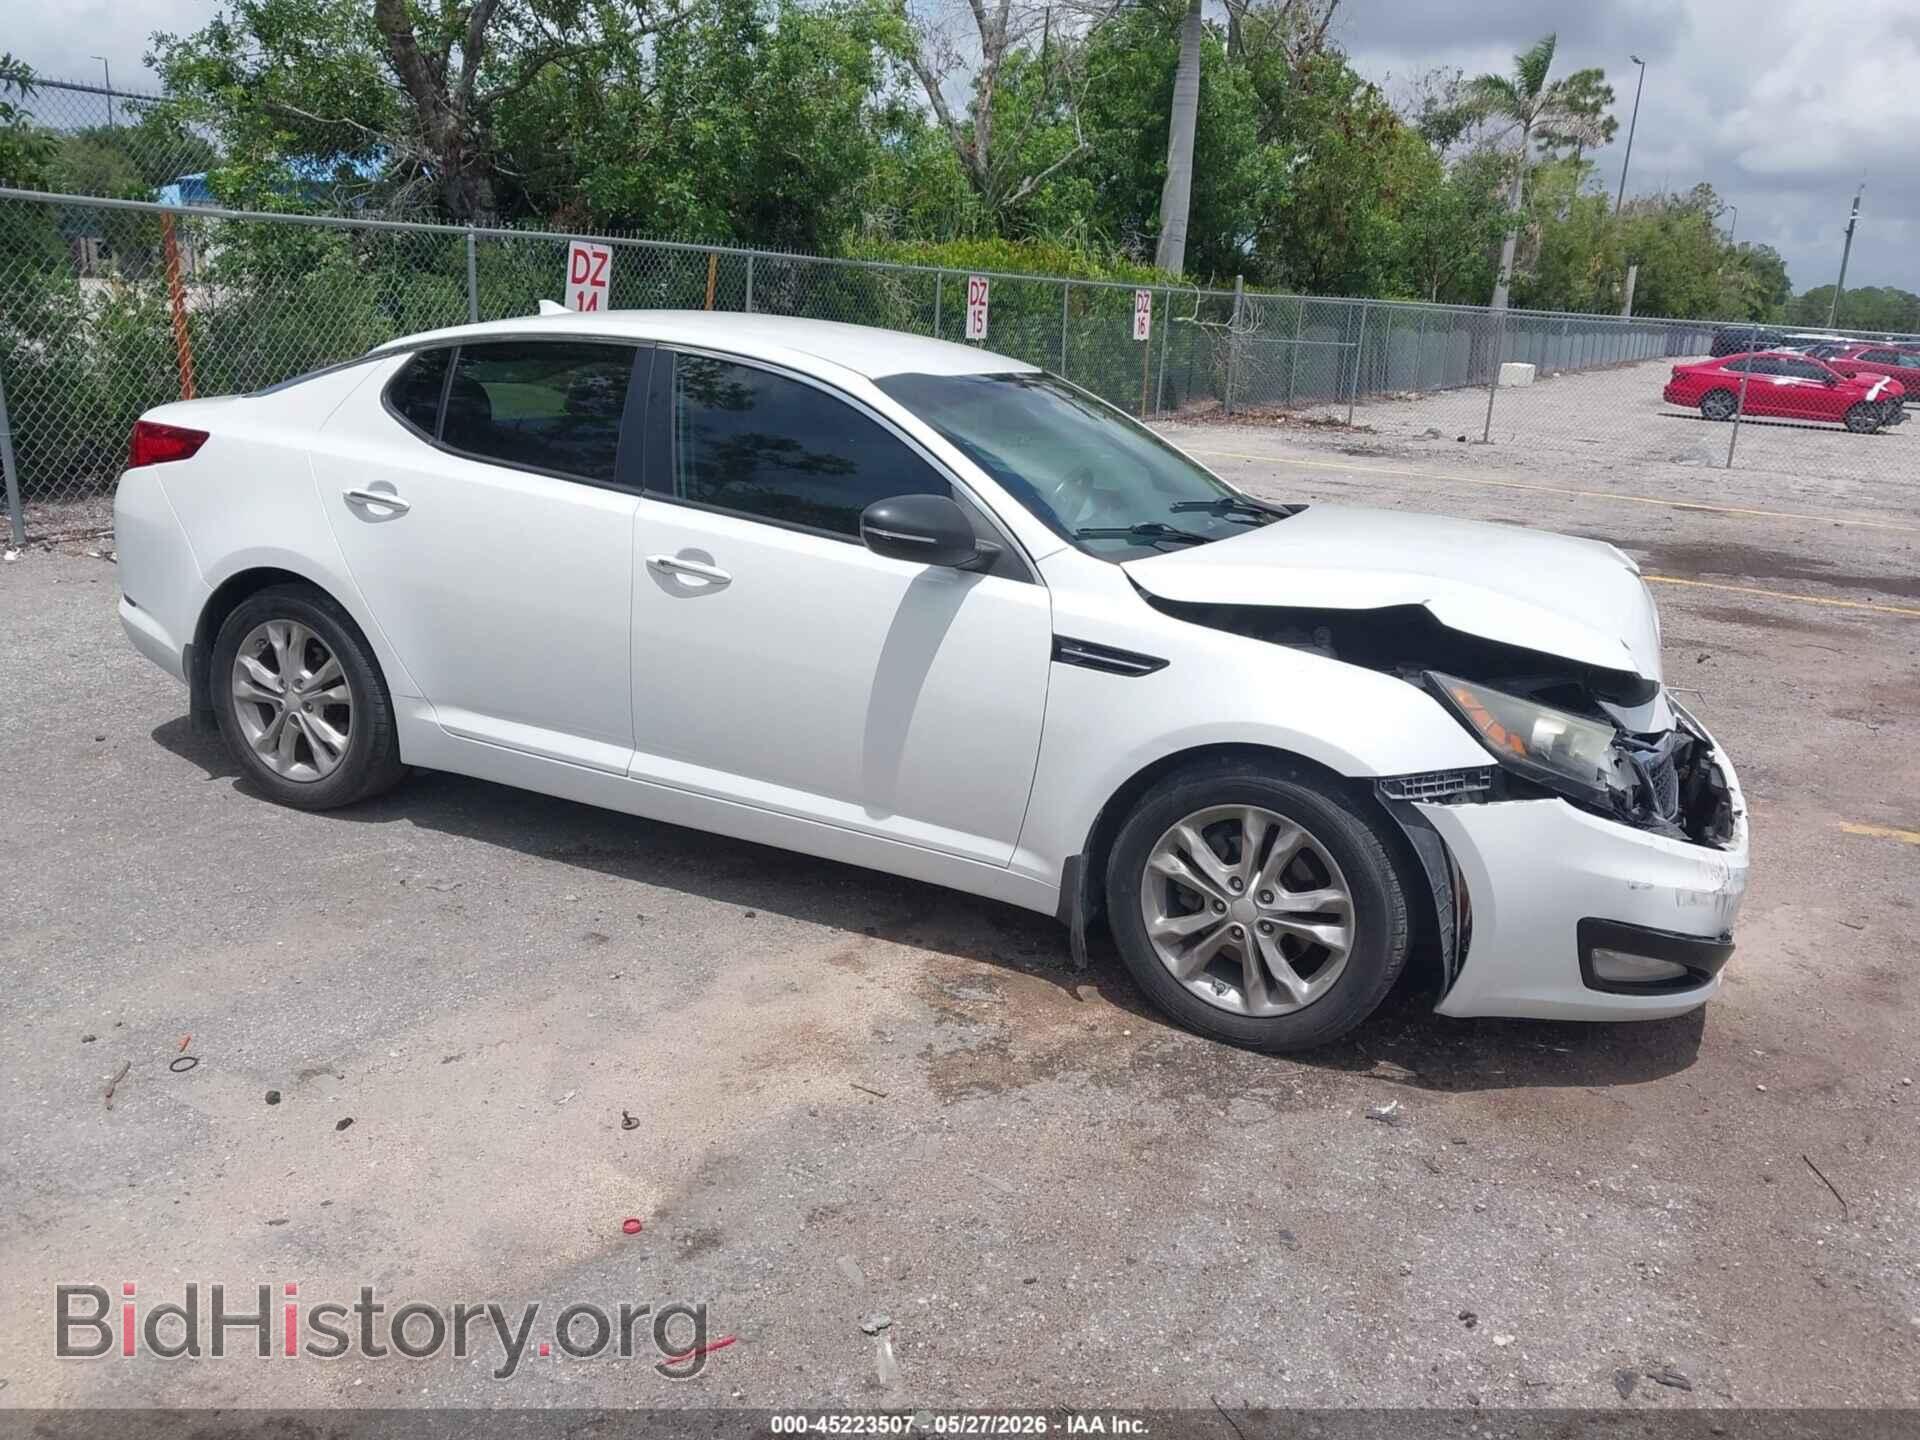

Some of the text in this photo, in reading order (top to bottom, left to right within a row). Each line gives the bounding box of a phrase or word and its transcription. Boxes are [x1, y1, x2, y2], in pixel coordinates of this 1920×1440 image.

[572, 248, 608, 287] DZ
[970, 281, 987, 306] DZ
[1136, 293, 1150, 314] DZ
[972, 310, 983, 334] 15
